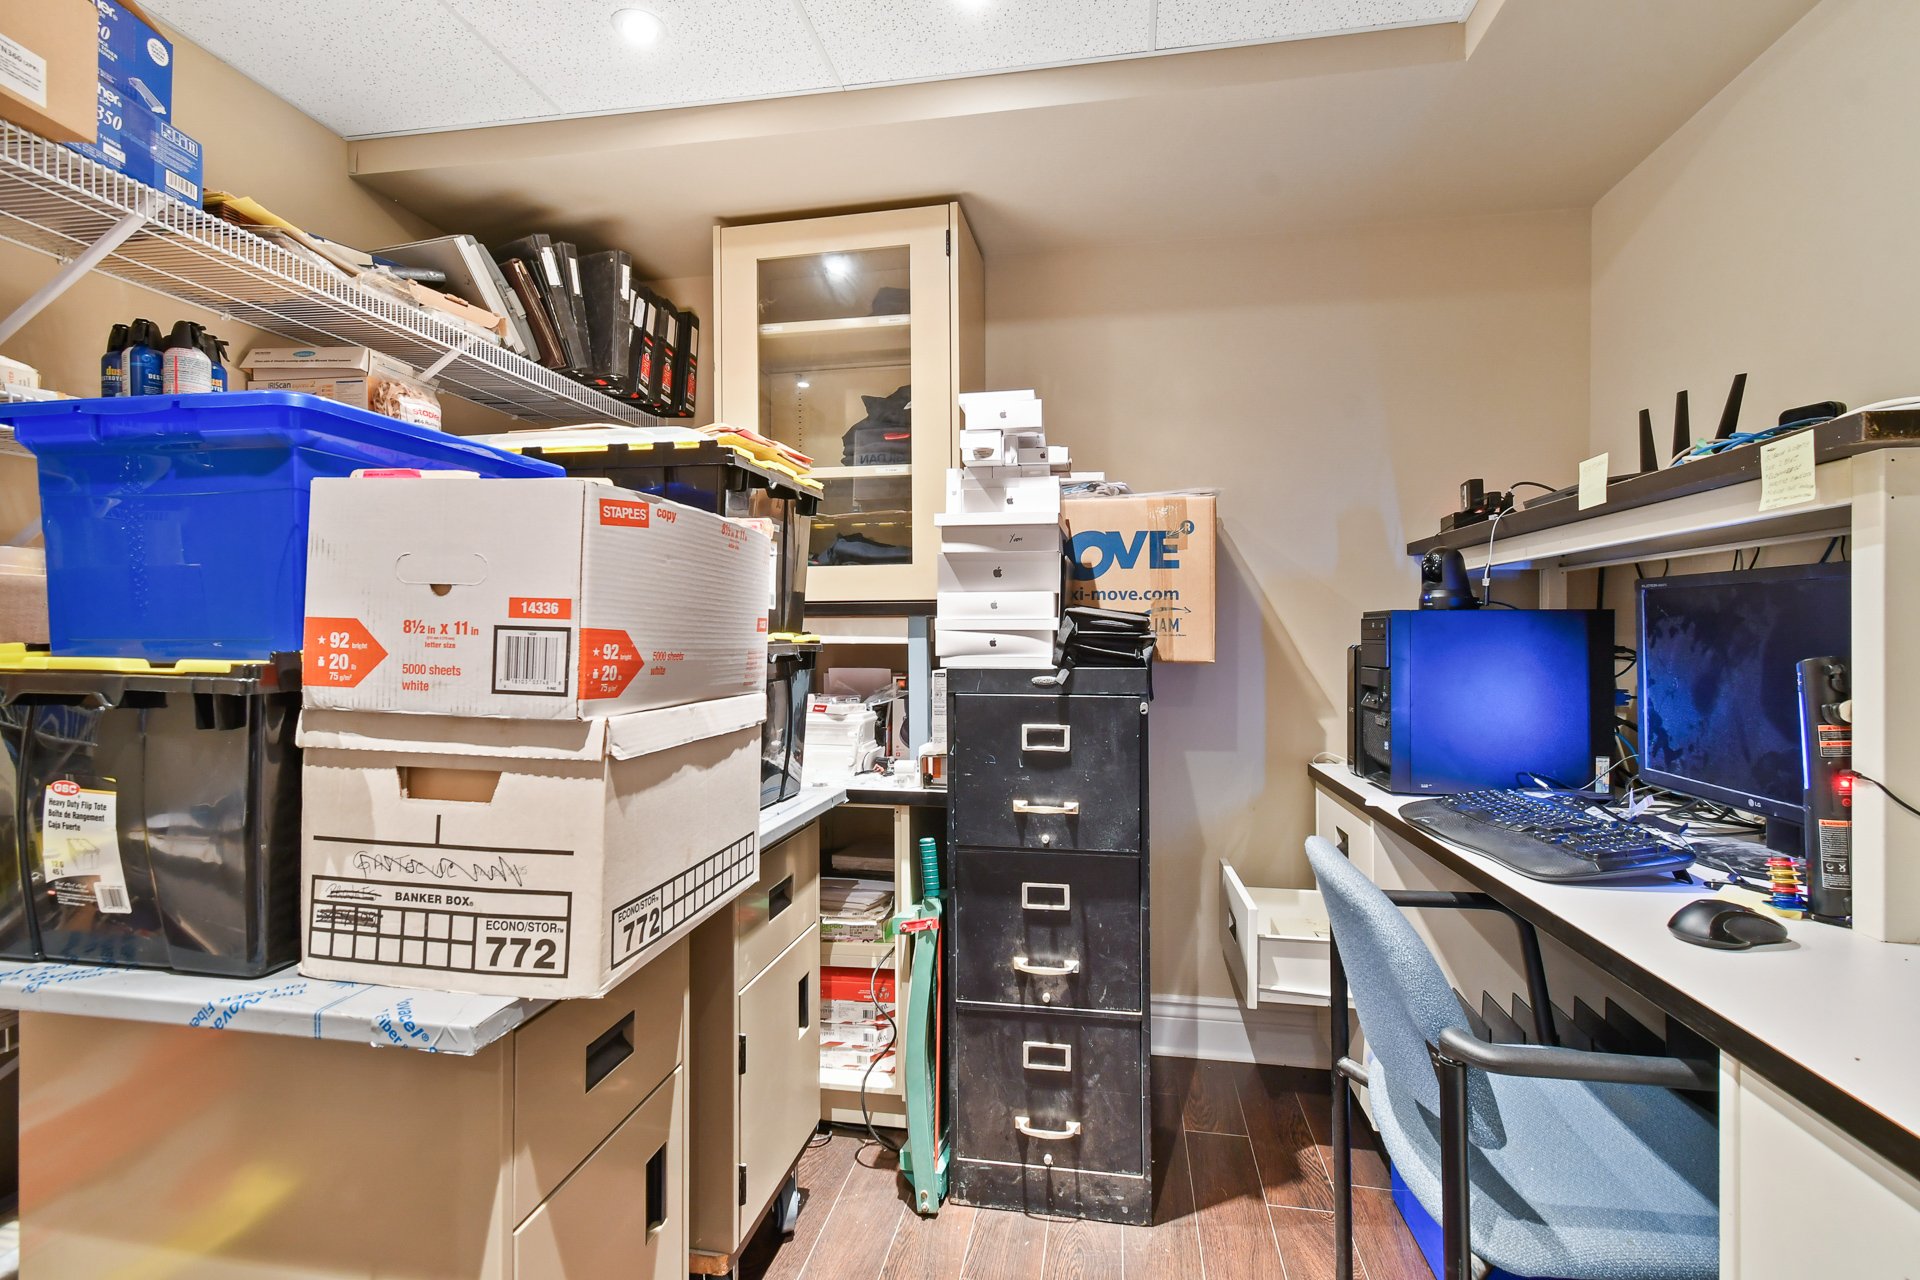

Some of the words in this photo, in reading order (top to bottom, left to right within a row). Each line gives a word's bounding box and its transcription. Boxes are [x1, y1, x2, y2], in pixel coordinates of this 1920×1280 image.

[603, 505, 647, 521] STAPLES
[656, 508, 677, 523] copy
[1063, 530, 1180, 581] OVE
[1072, 586, 1180, 601] xi-move.com
[521, 601, 559, 615] 14336
[427, 625, 436, 635] in
[454, 620, 469, 636] 11
[470, 626, 479, 636] in
[329, 631, 350, 649] 92
[351, 642, 368, 650] bright
[424, 641, 442, 649] letter
[603, 643, 620, 660] 92
[652, 651, 667, 661] 5000
[667, 652, 685, 661] sheets
[329, 653, 349, 671] 20
[329, 671, 339, 681] 75
[402, 663, 427, 675] 5000
[428, 664, 462, 677] sheets
[601, 665, 617, 682] 20
[650, 666, 666, 676] white
[402, 680, 430, 692] white
[600, 683, 609, 692] 75
[54, 783, 77, 794] GSC
[48, 798, 65, 808] Heavy
[67, 800, 80, 809] Duty
[81, 801, 92, 811] Flip
[94, 802, 107, 811] Tote
[64, 811, 71, 819] de
[72, 811, 105, 822] Rangement
[48, 820, 61, 830] Caja
[62, 822, 81, 831] Fuerte
[395, 892, 442, 904] BANKER
[623, 907, 660, 953] 772
[486, 936, 556, 969] 772
[396, 998, 424, 1039] ovacel
